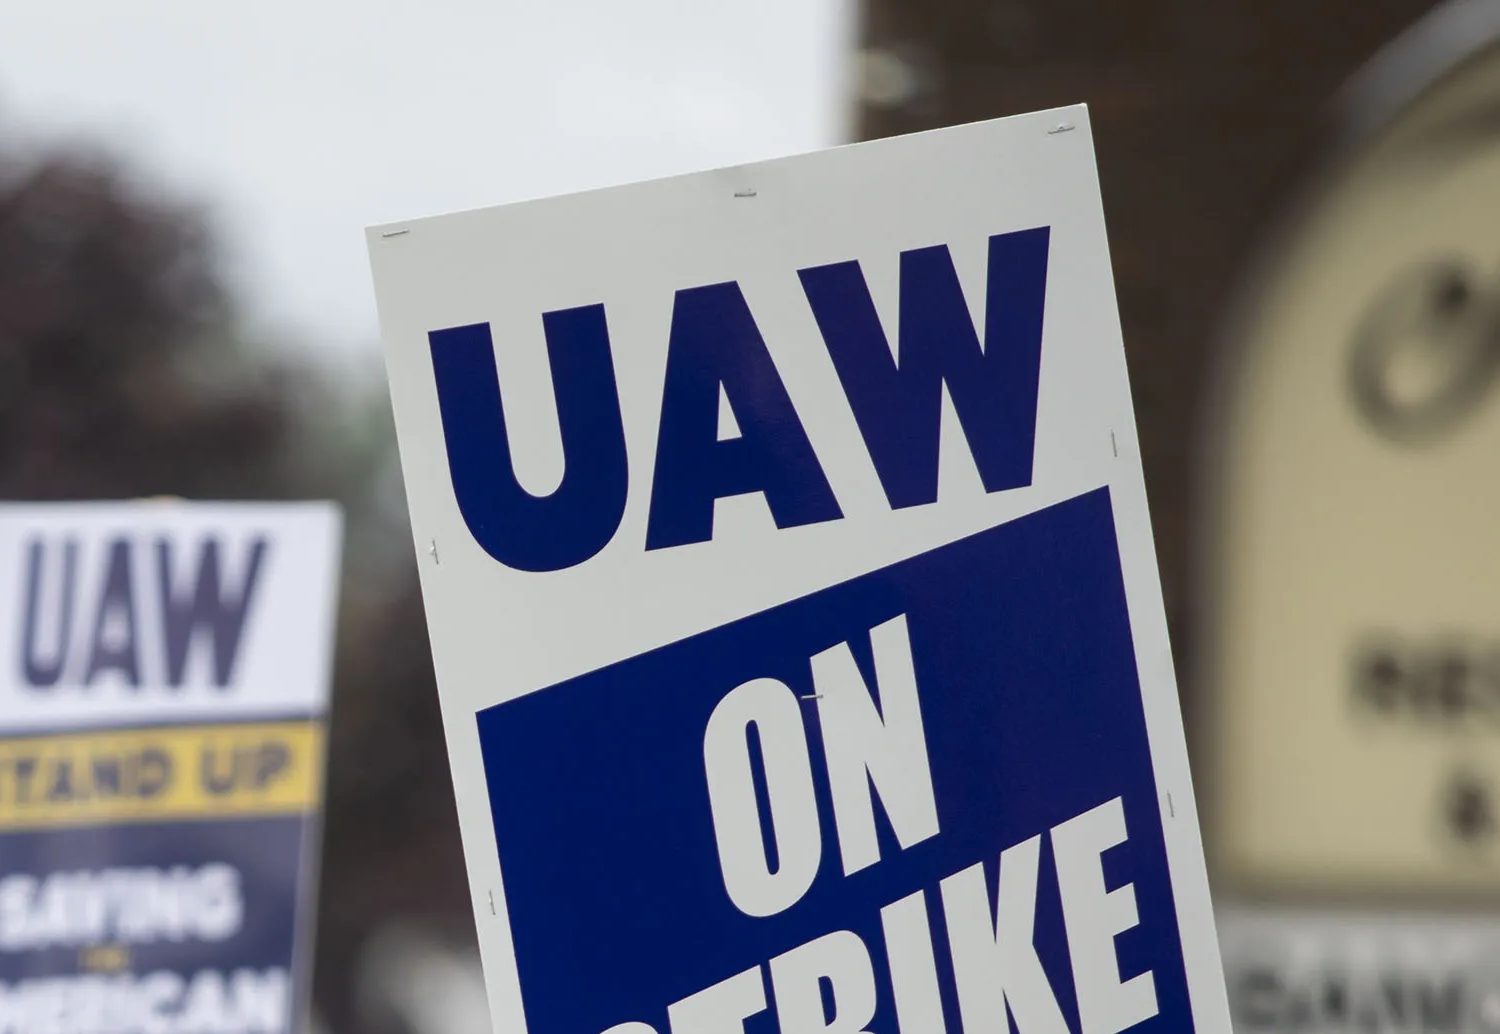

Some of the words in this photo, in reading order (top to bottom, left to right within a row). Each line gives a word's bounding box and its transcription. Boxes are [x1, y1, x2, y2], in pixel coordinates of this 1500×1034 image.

[428, 226, 1050, 572] UAW
[16, 530, 274, 690] UAW
[200, 737, 292, 797] UP
[704, 613, 940, 917] ON
